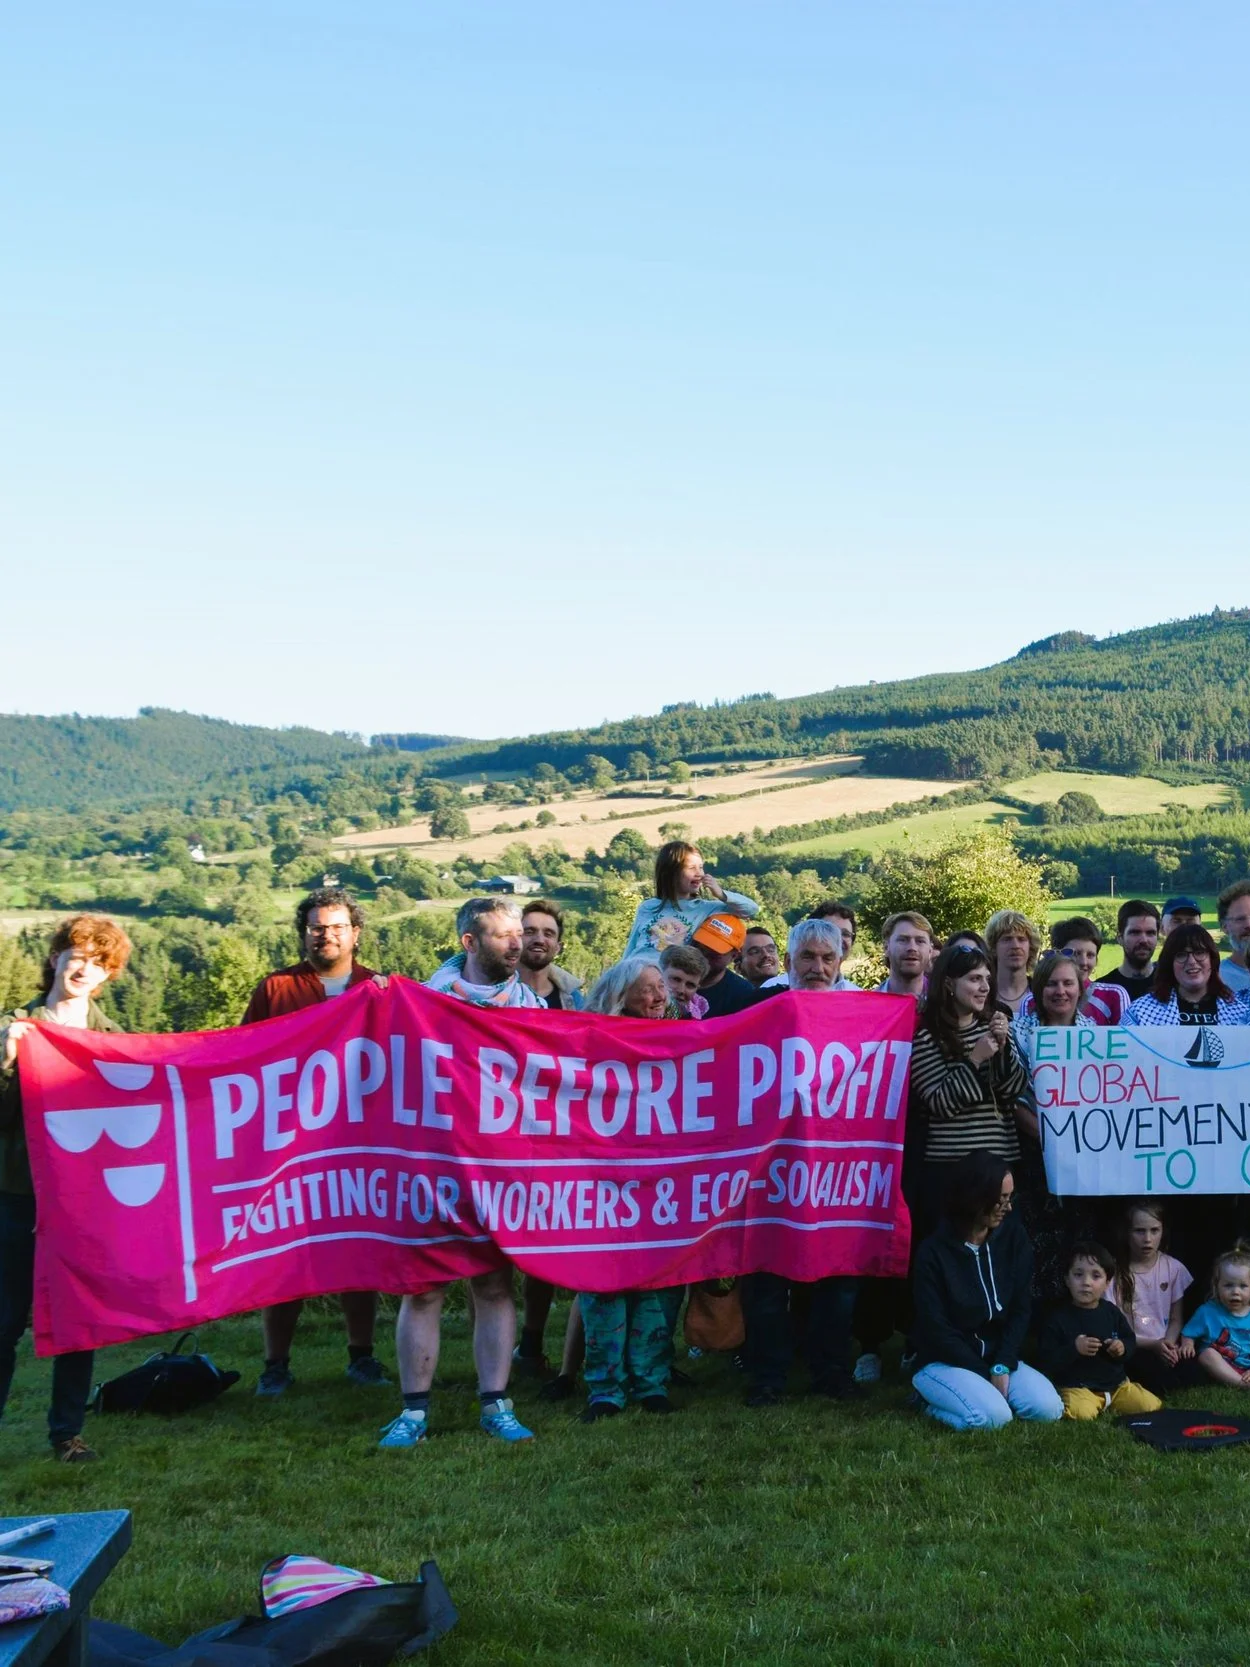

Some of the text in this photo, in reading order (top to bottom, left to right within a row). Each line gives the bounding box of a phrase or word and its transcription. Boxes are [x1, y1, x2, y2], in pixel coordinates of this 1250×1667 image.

[209, 1035, 912, 1159] PEOPLE BEFORE PROFIT
[1032, 1064, 1180, 1107] GLOBAL
[1134, 1149, 1197, 1191] TO
[221, 1167, 388, 1250] FIGHTING
[395, 1172, 463, 1223] FOR
[471, 1178, 641, 1232] WORKERS
[652, 1177, 680, 1226] &
